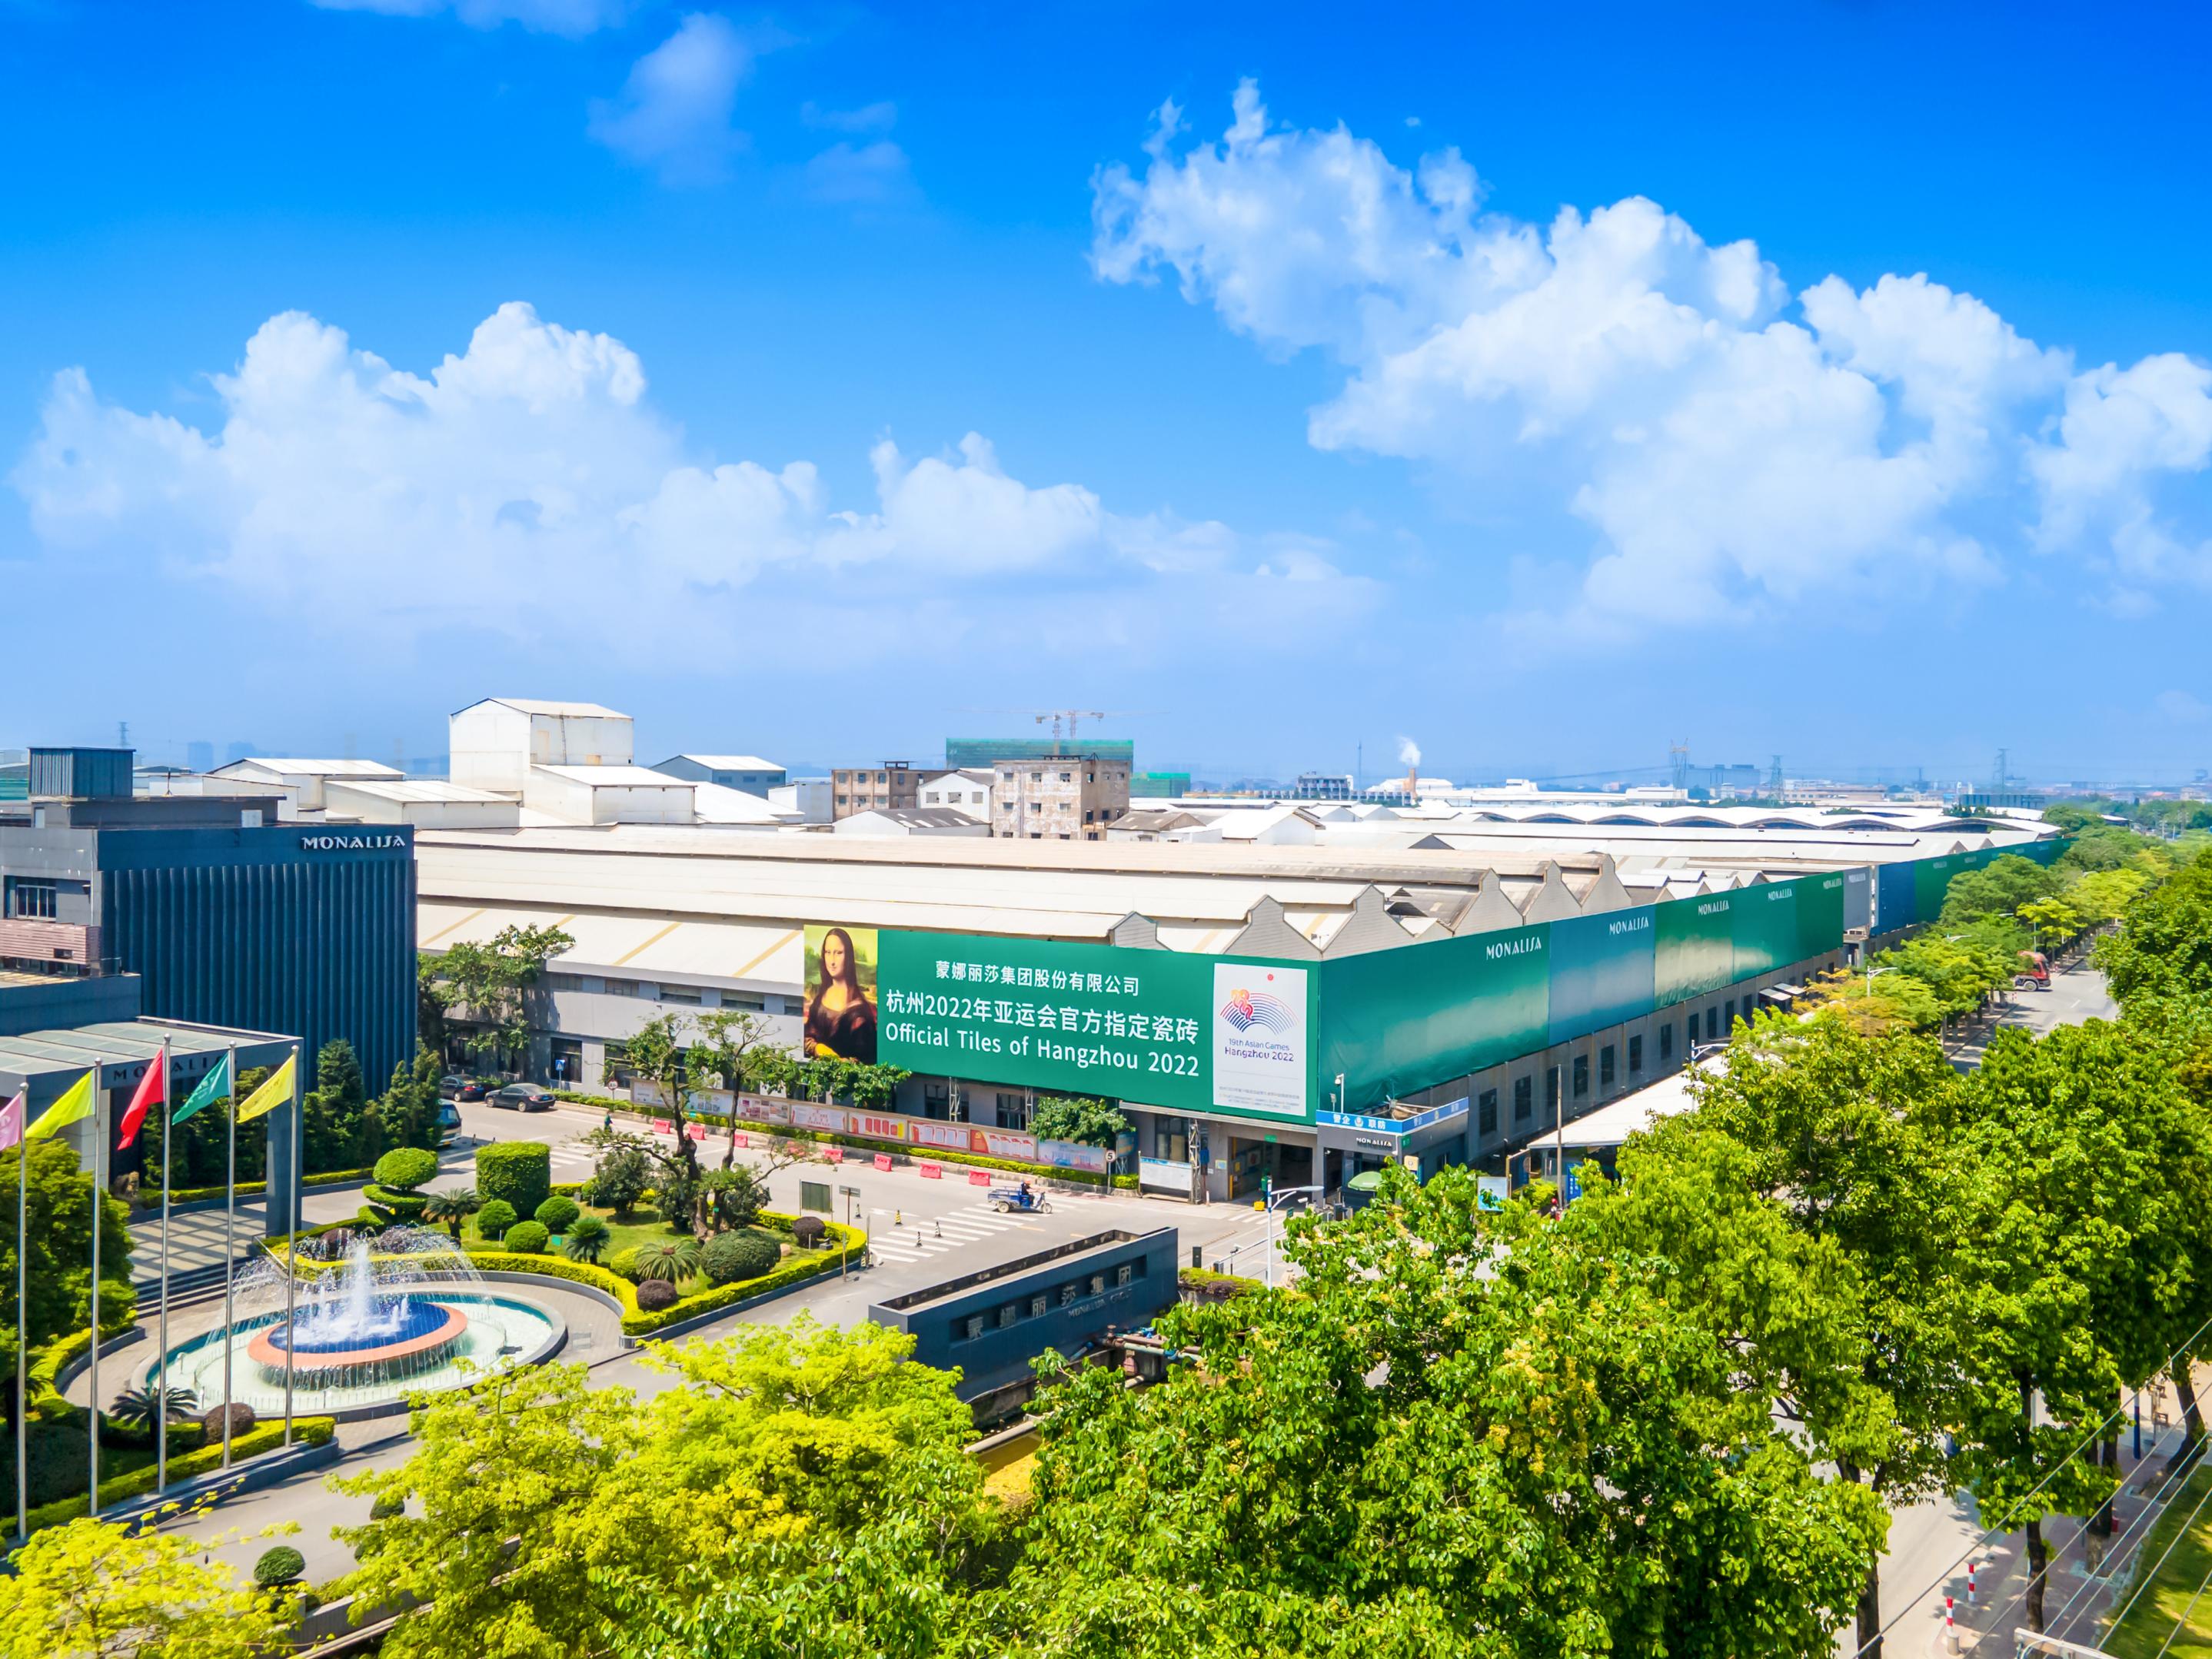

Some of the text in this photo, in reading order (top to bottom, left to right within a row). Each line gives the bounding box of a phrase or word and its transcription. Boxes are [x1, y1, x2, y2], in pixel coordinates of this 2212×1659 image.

[301, 835, 405, 849] MONALISA
[1768, 888, 1792, 901] MONALISA
[1698, 899, 1729, 916] MONALISA
[1609, 916, 1649, 935] MONALISA
[1486, 936, 1542, 960] MONALISA
[935, 960, 1139, 996] 蒙娜丽莎集团股份有限公司
[886, 989, 1199, 1046] 杭州2022年亚运会官方指定瓷砖
[886, 1022, 1199, 1076] Official Tiles of Hangzhou 2022
[1229, 1038, 1244, 1046] 19th
[1265, 1042, 1289, 1051] Games
[1225, 1046, 1294, 1062] Hangzhou 2022
[114, 1055, 238, 1080] MOALI
[1355, 1137, 1392, 1147] MONALISA
